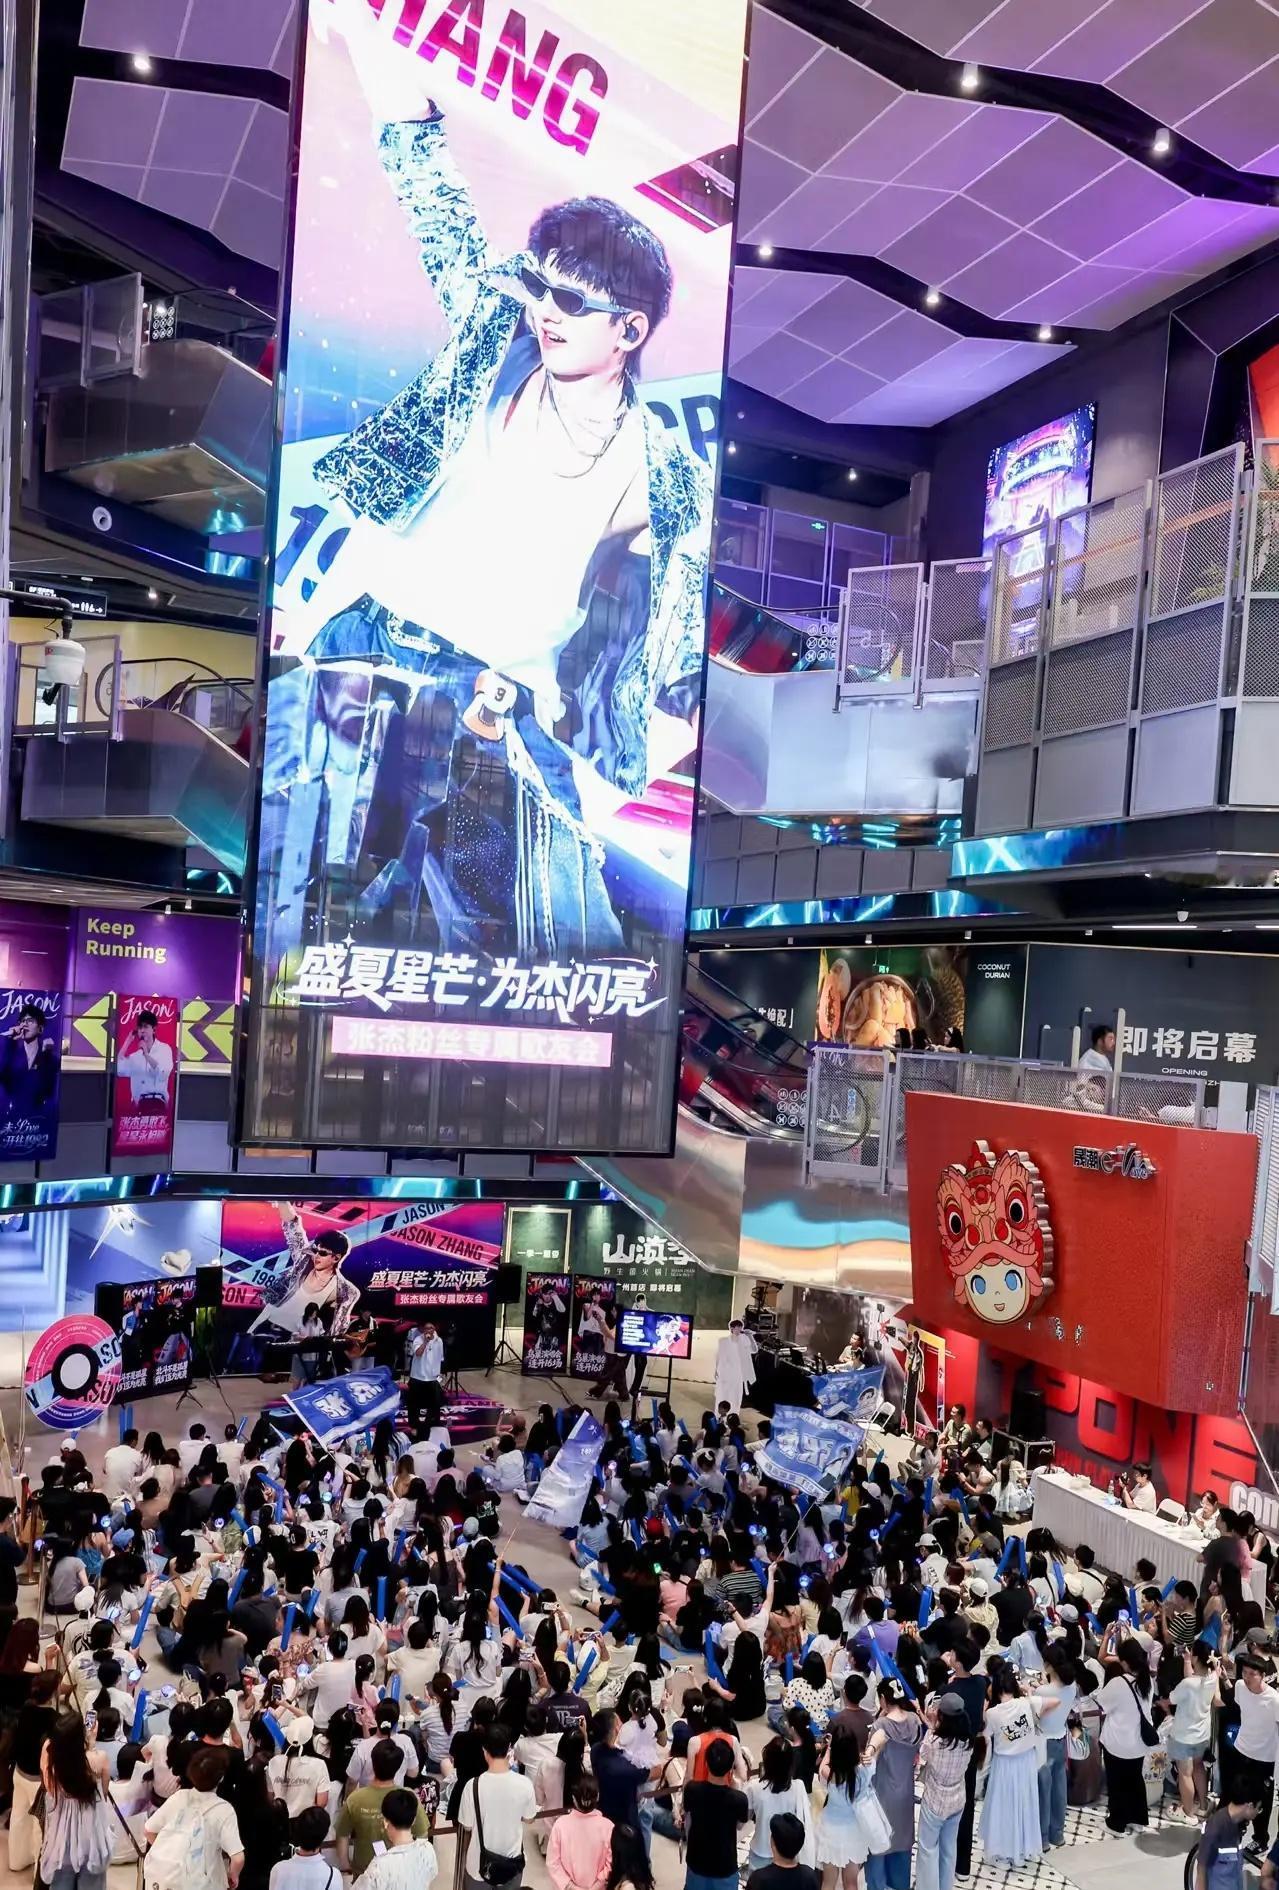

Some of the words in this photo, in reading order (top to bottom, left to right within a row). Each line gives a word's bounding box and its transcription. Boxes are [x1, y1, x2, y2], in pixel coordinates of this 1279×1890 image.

[87, 918, 135, 939] Keep
[86, 940, 167, 964] Running
[977, 963, 1012, 971] COCONUT
[985, 971, 1011, 979] DURIAN
[287, 942, 668, 1025] 盛夏星芒·为杰闪亮
[120, 997, 175, 1025] JASON
[347, 1021, 602, 1064] 张杰粉丝专属歌友会
[1121, 1026, 1258, 1064] 即将启幕
[1161, 1067, 1208, 1077] OPENING
[402, 1202, 445, 1224] JASON
[437, 1235, 484, 1261] ZHANG
[366, 1269, 493, 1291] 盛夏星芒·为杰闪亮
[400, 1294, 484, 1305] 张杰粉丝专属歌友会
[121, 1367, 148, 1382] 斗不是孤星
